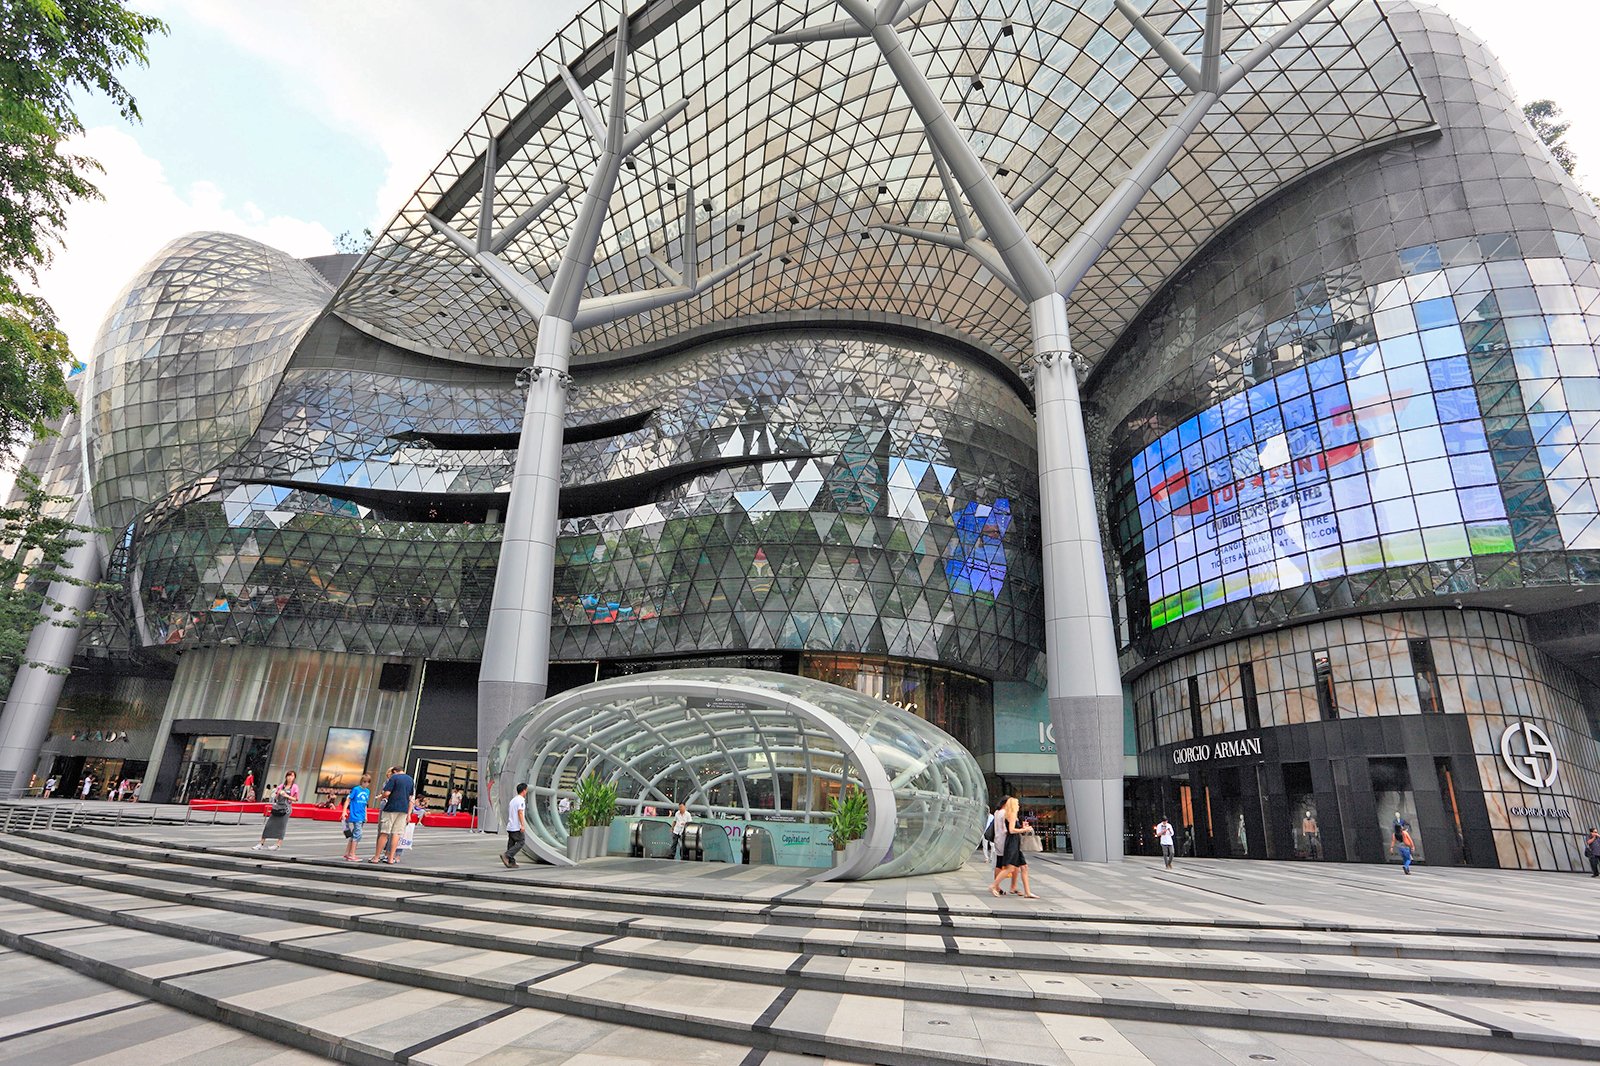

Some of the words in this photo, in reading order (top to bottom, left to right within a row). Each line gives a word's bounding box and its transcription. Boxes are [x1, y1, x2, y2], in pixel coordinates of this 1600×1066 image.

[1212, 480, 1245, 505] TOP
[1212, 513, 1241, 533] PUBLIC
[1303, 486, 1323, 502] FEB
[71, 729, 128, 743] RADA
[1173, 744, 1210, 764] GIORGIO
[1214, 737, 1262, 759] ARMANI
[782, 834, 810, 844] CapitaLand
